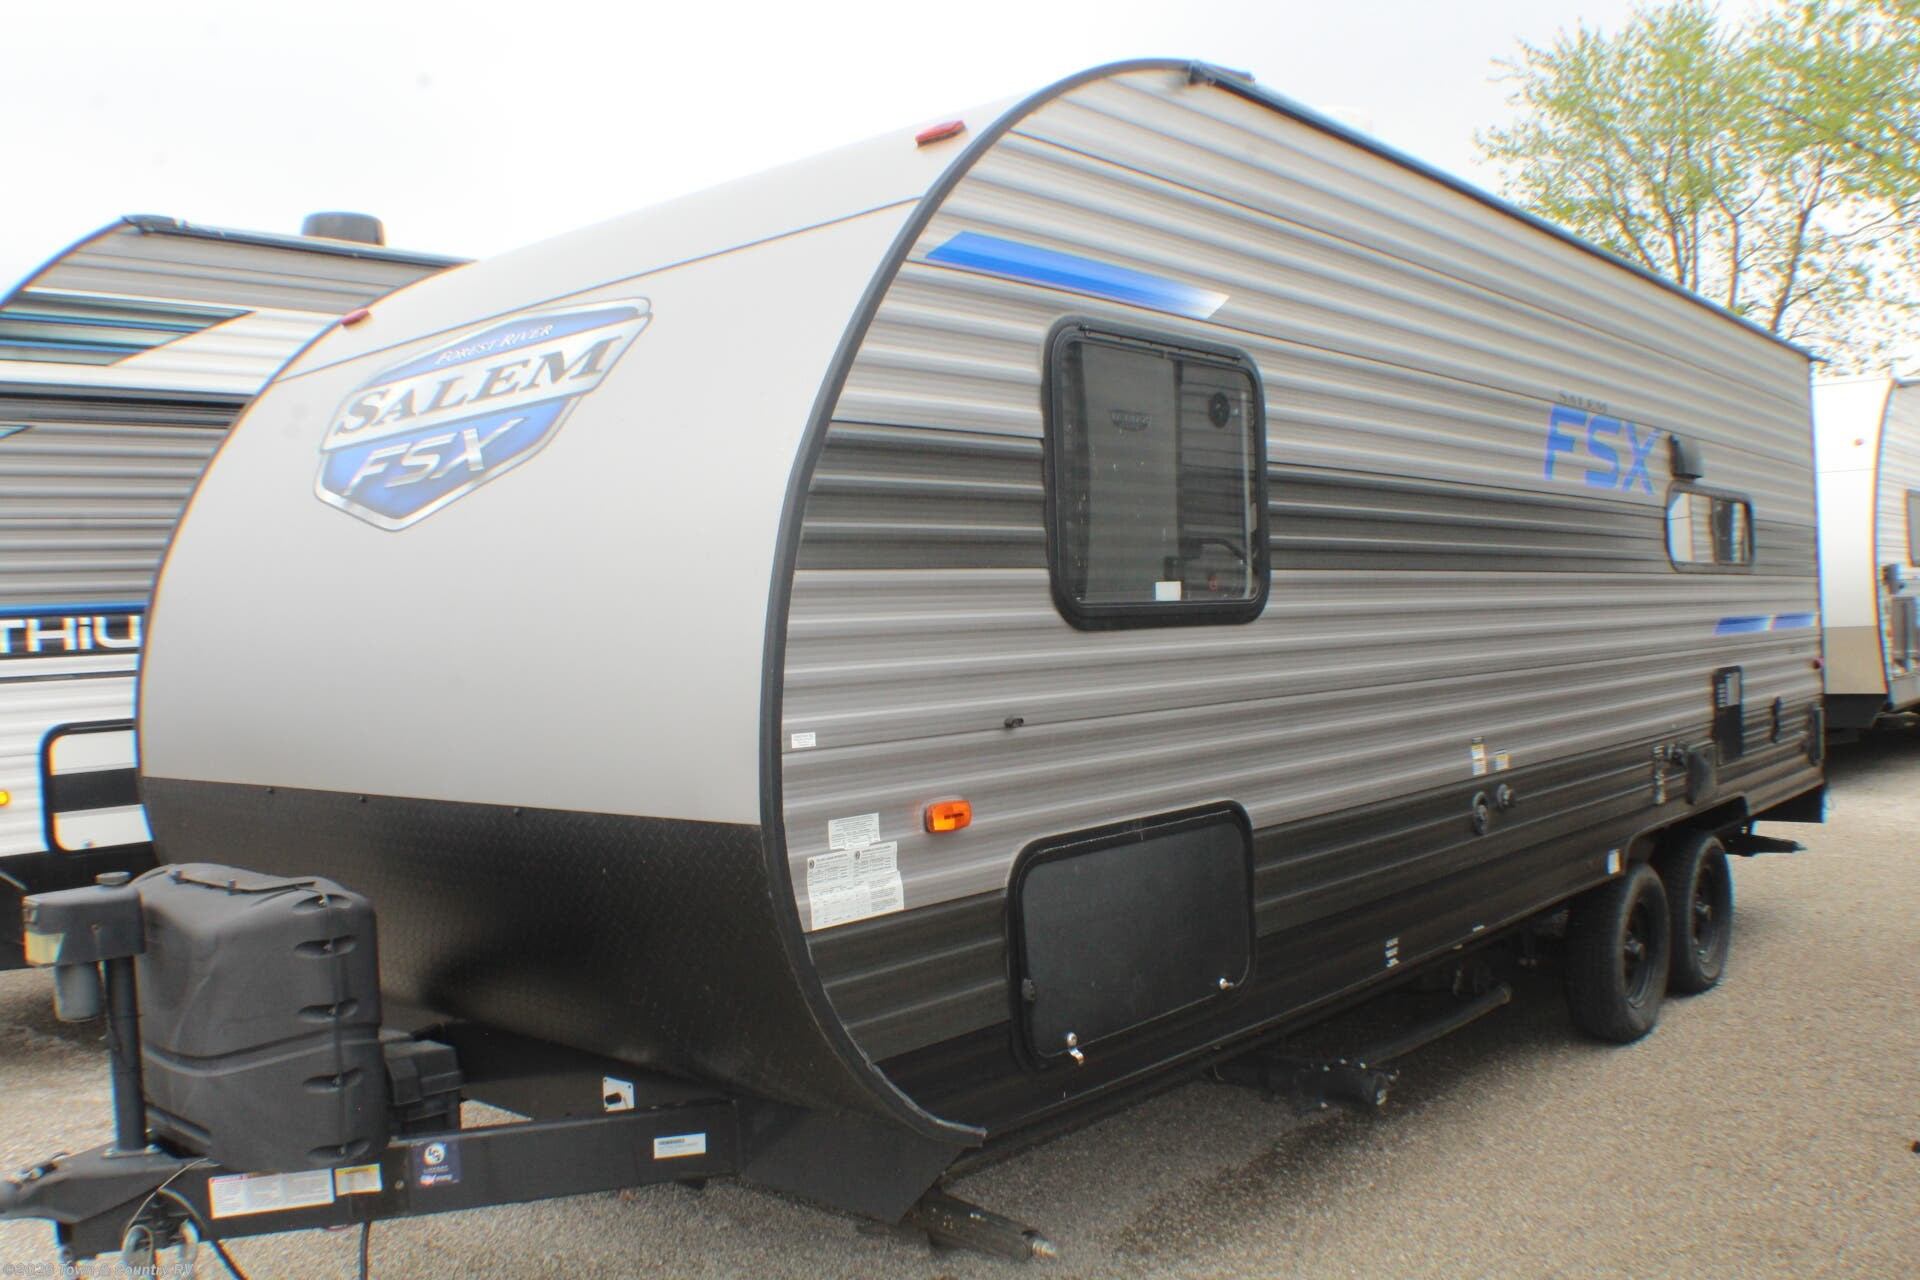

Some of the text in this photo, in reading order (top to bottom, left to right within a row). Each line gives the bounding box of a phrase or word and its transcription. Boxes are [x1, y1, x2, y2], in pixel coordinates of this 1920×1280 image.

[334, 335, 623, 437] SALEM
[343, 416, 530, 497] FSX
[1545, 406, 1660, 495] FSX
